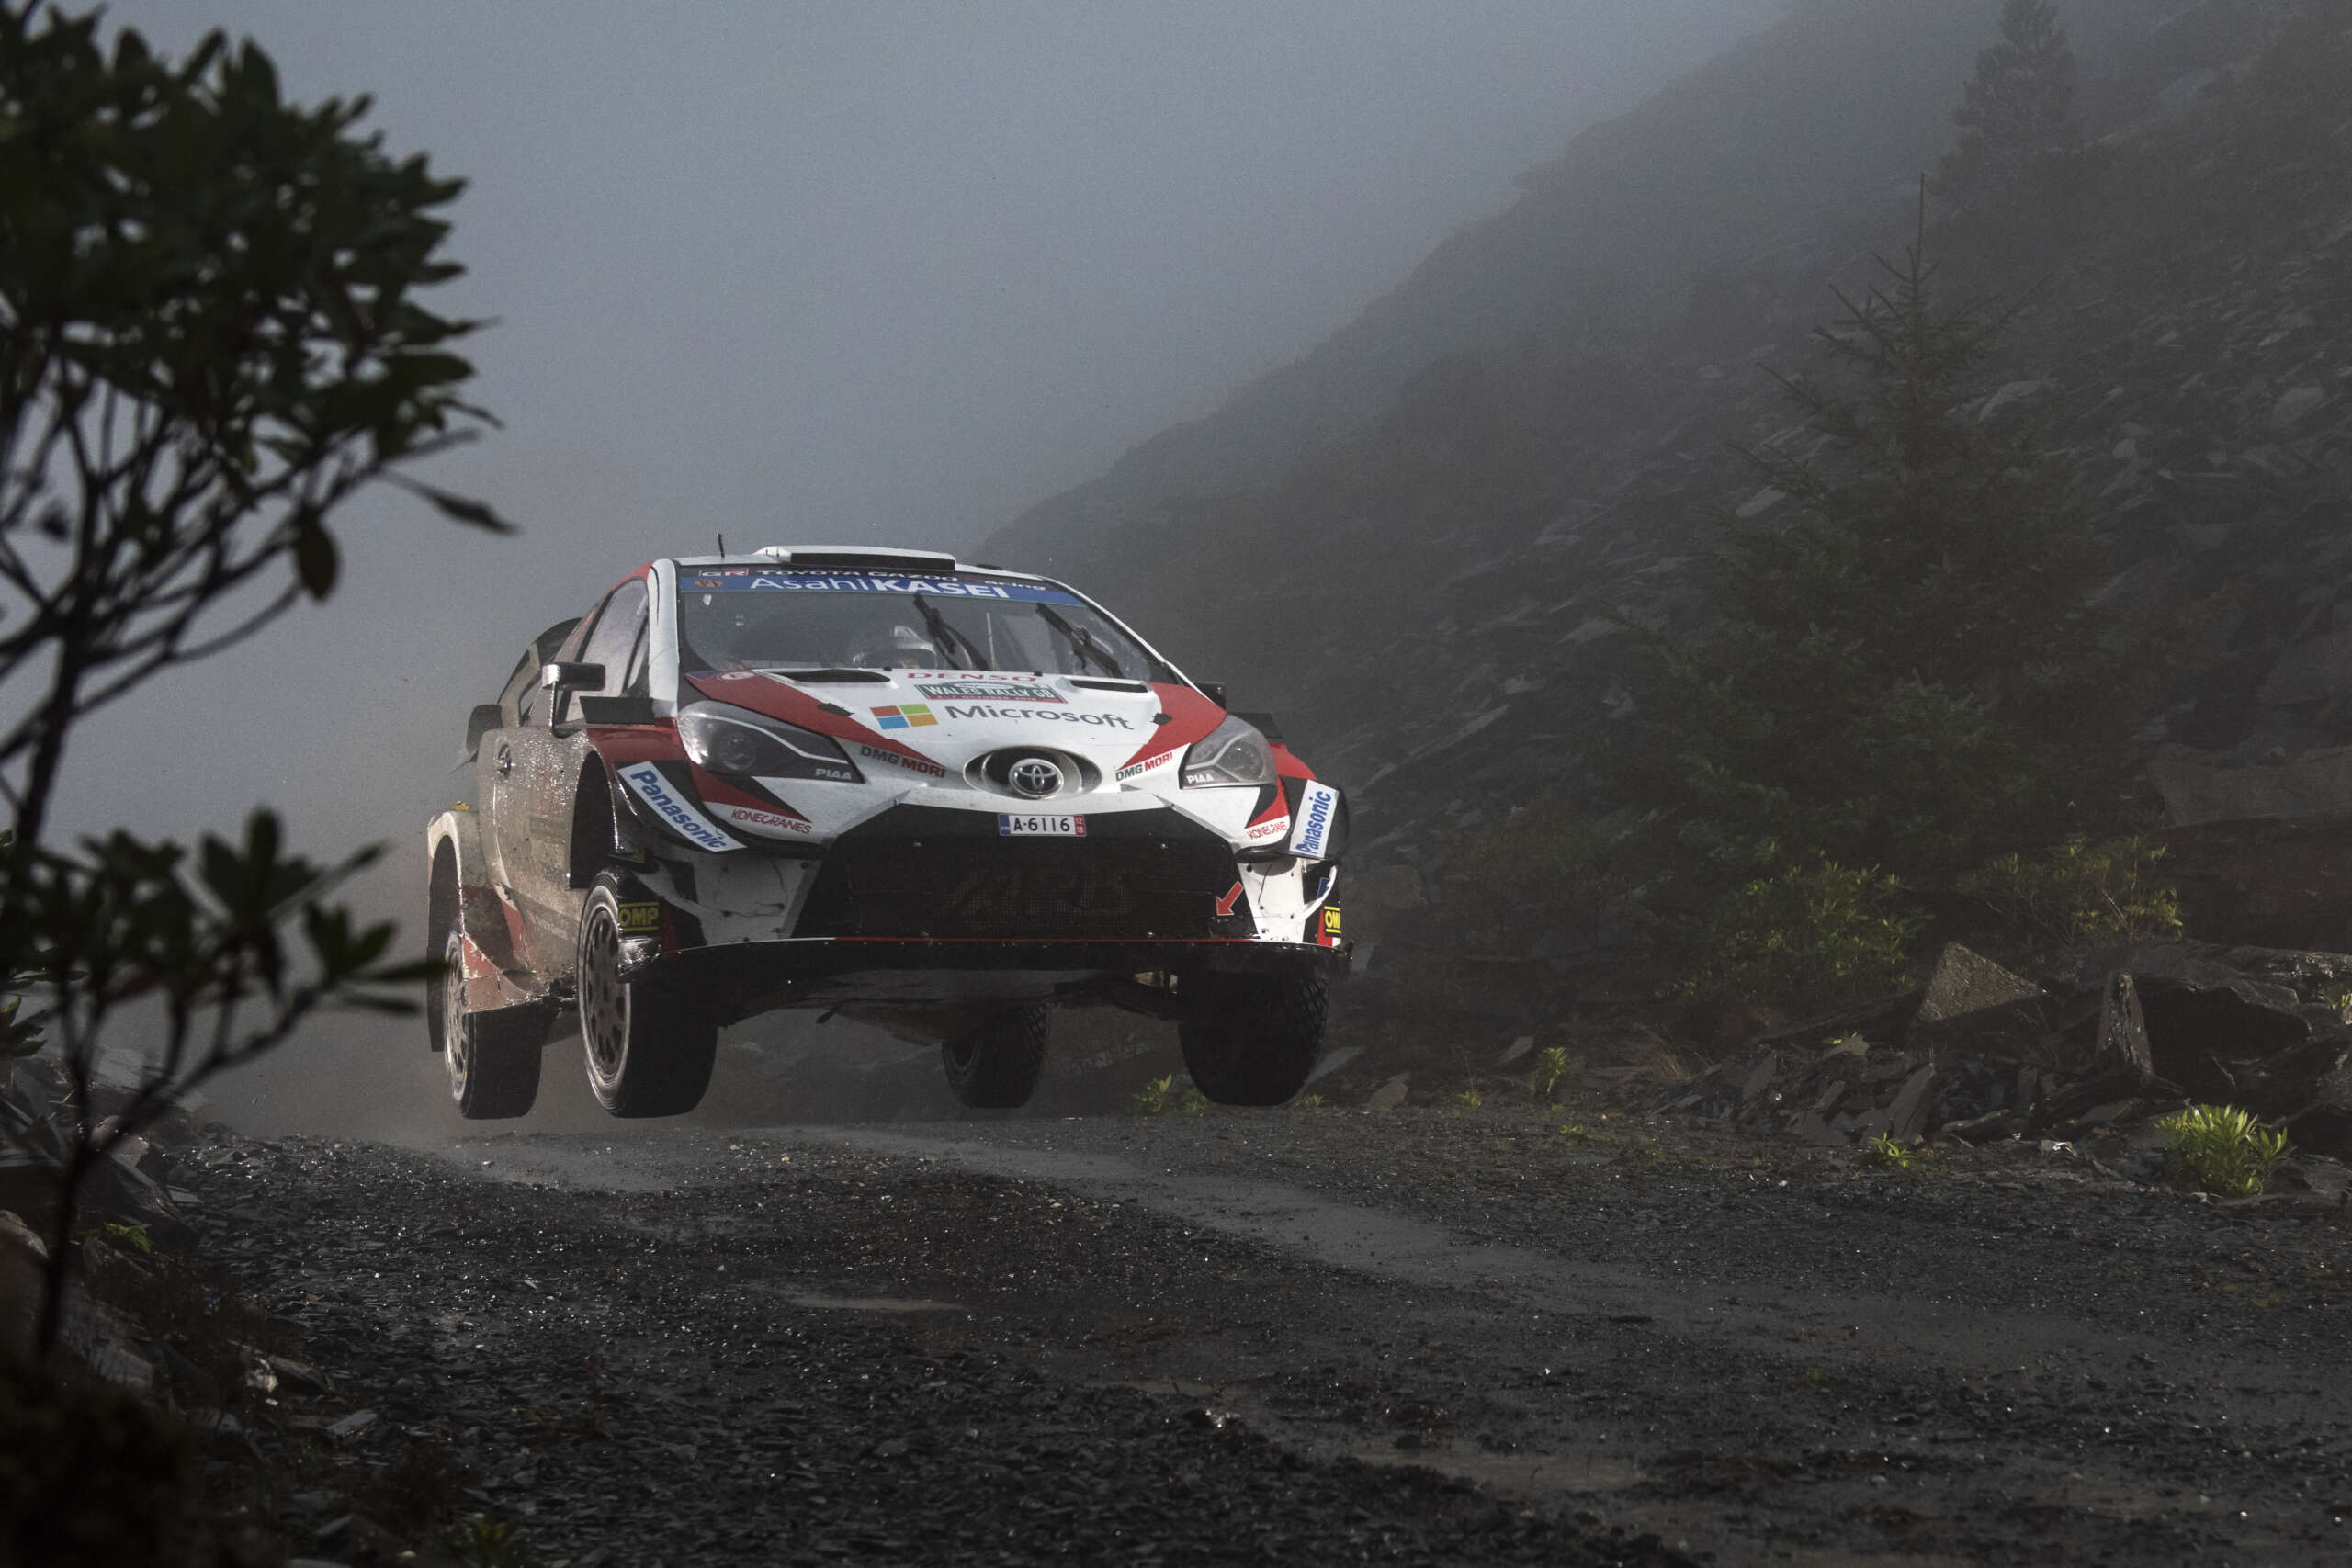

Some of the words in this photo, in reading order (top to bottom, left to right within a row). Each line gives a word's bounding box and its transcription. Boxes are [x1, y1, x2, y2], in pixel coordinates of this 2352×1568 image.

[868, 571, 958, 581] GAZOO
[908, 672, 1036, 682] DENSO
[924, 684, 982, 695] WALES
[986, 688, 1030, 697] RALLY
[1033, 689, 1055, 699] GB
[944, 705, 1135, 730] Microsoft
[860, 745, 899, 765] DMG
[901, 756, 946, 778] MORI
[1115, 764, 1144, 782] DMG
[1144, 752, 1173, 772] MORI
[815, 768, 853, 780] PIAA
[1186, 773, 1214, 784] PIAA
[630, 770, 728, 848] Panasonic
[730, 809, 813, 834] KONECRANES
[1013, 817, 1070, 832] A-6116
[1296, 791, 1331, 854] Panasonic
[618, 907, 660, 927] OMP
